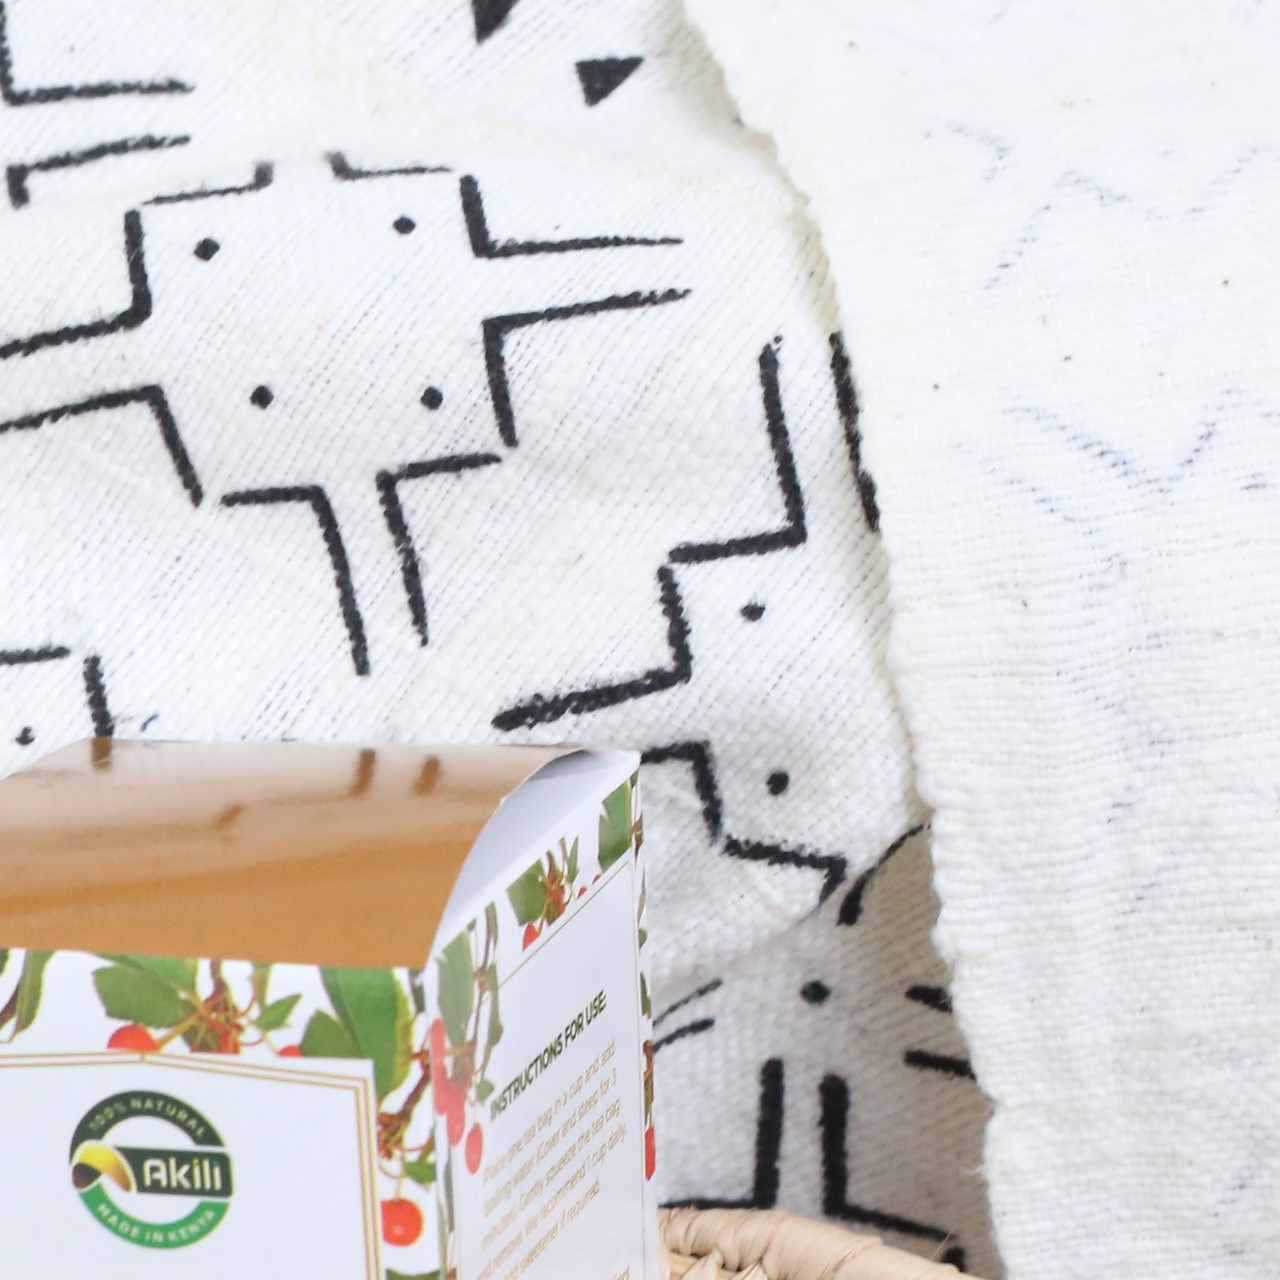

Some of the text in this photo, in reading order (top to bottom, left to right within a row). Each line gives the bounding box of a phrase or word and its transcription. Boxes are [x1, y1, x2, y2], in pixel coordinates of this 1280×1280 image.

[491, 1033, 563, 1122] INSTRUCTIONS
[564, 1012, 584, 1049] FOR
[537, 1107, 553, 1132] bag
[569, 1075, 584, 1097] cup
[585, 1054, 600, 1083] and
[600, 1038, 616, 1067] add
[561, 1107, 577, 1137] and
[578, 1089, 600, 1121] steep
[600, 1076, 610, 1096] for
[610, 1067, 617, 1087] 3
[89, 1098, 206, 1137] 100% NATURAL
[545, 1144, 577, 1186] squeeze
[577, 1127, 590, 1152] the
[591, 1113, 604, 1137] tea
[605, 1097, 621, 1123] bag
[143, 1156, 222, 1191] Akili
[540, 1160, 586, 1219] recommend
[592, 1143, 608, 1167] cup
[97, 1203, 216, 1243] MADE IN KENYA
[520, 1222, 560, 1273] sweetener
